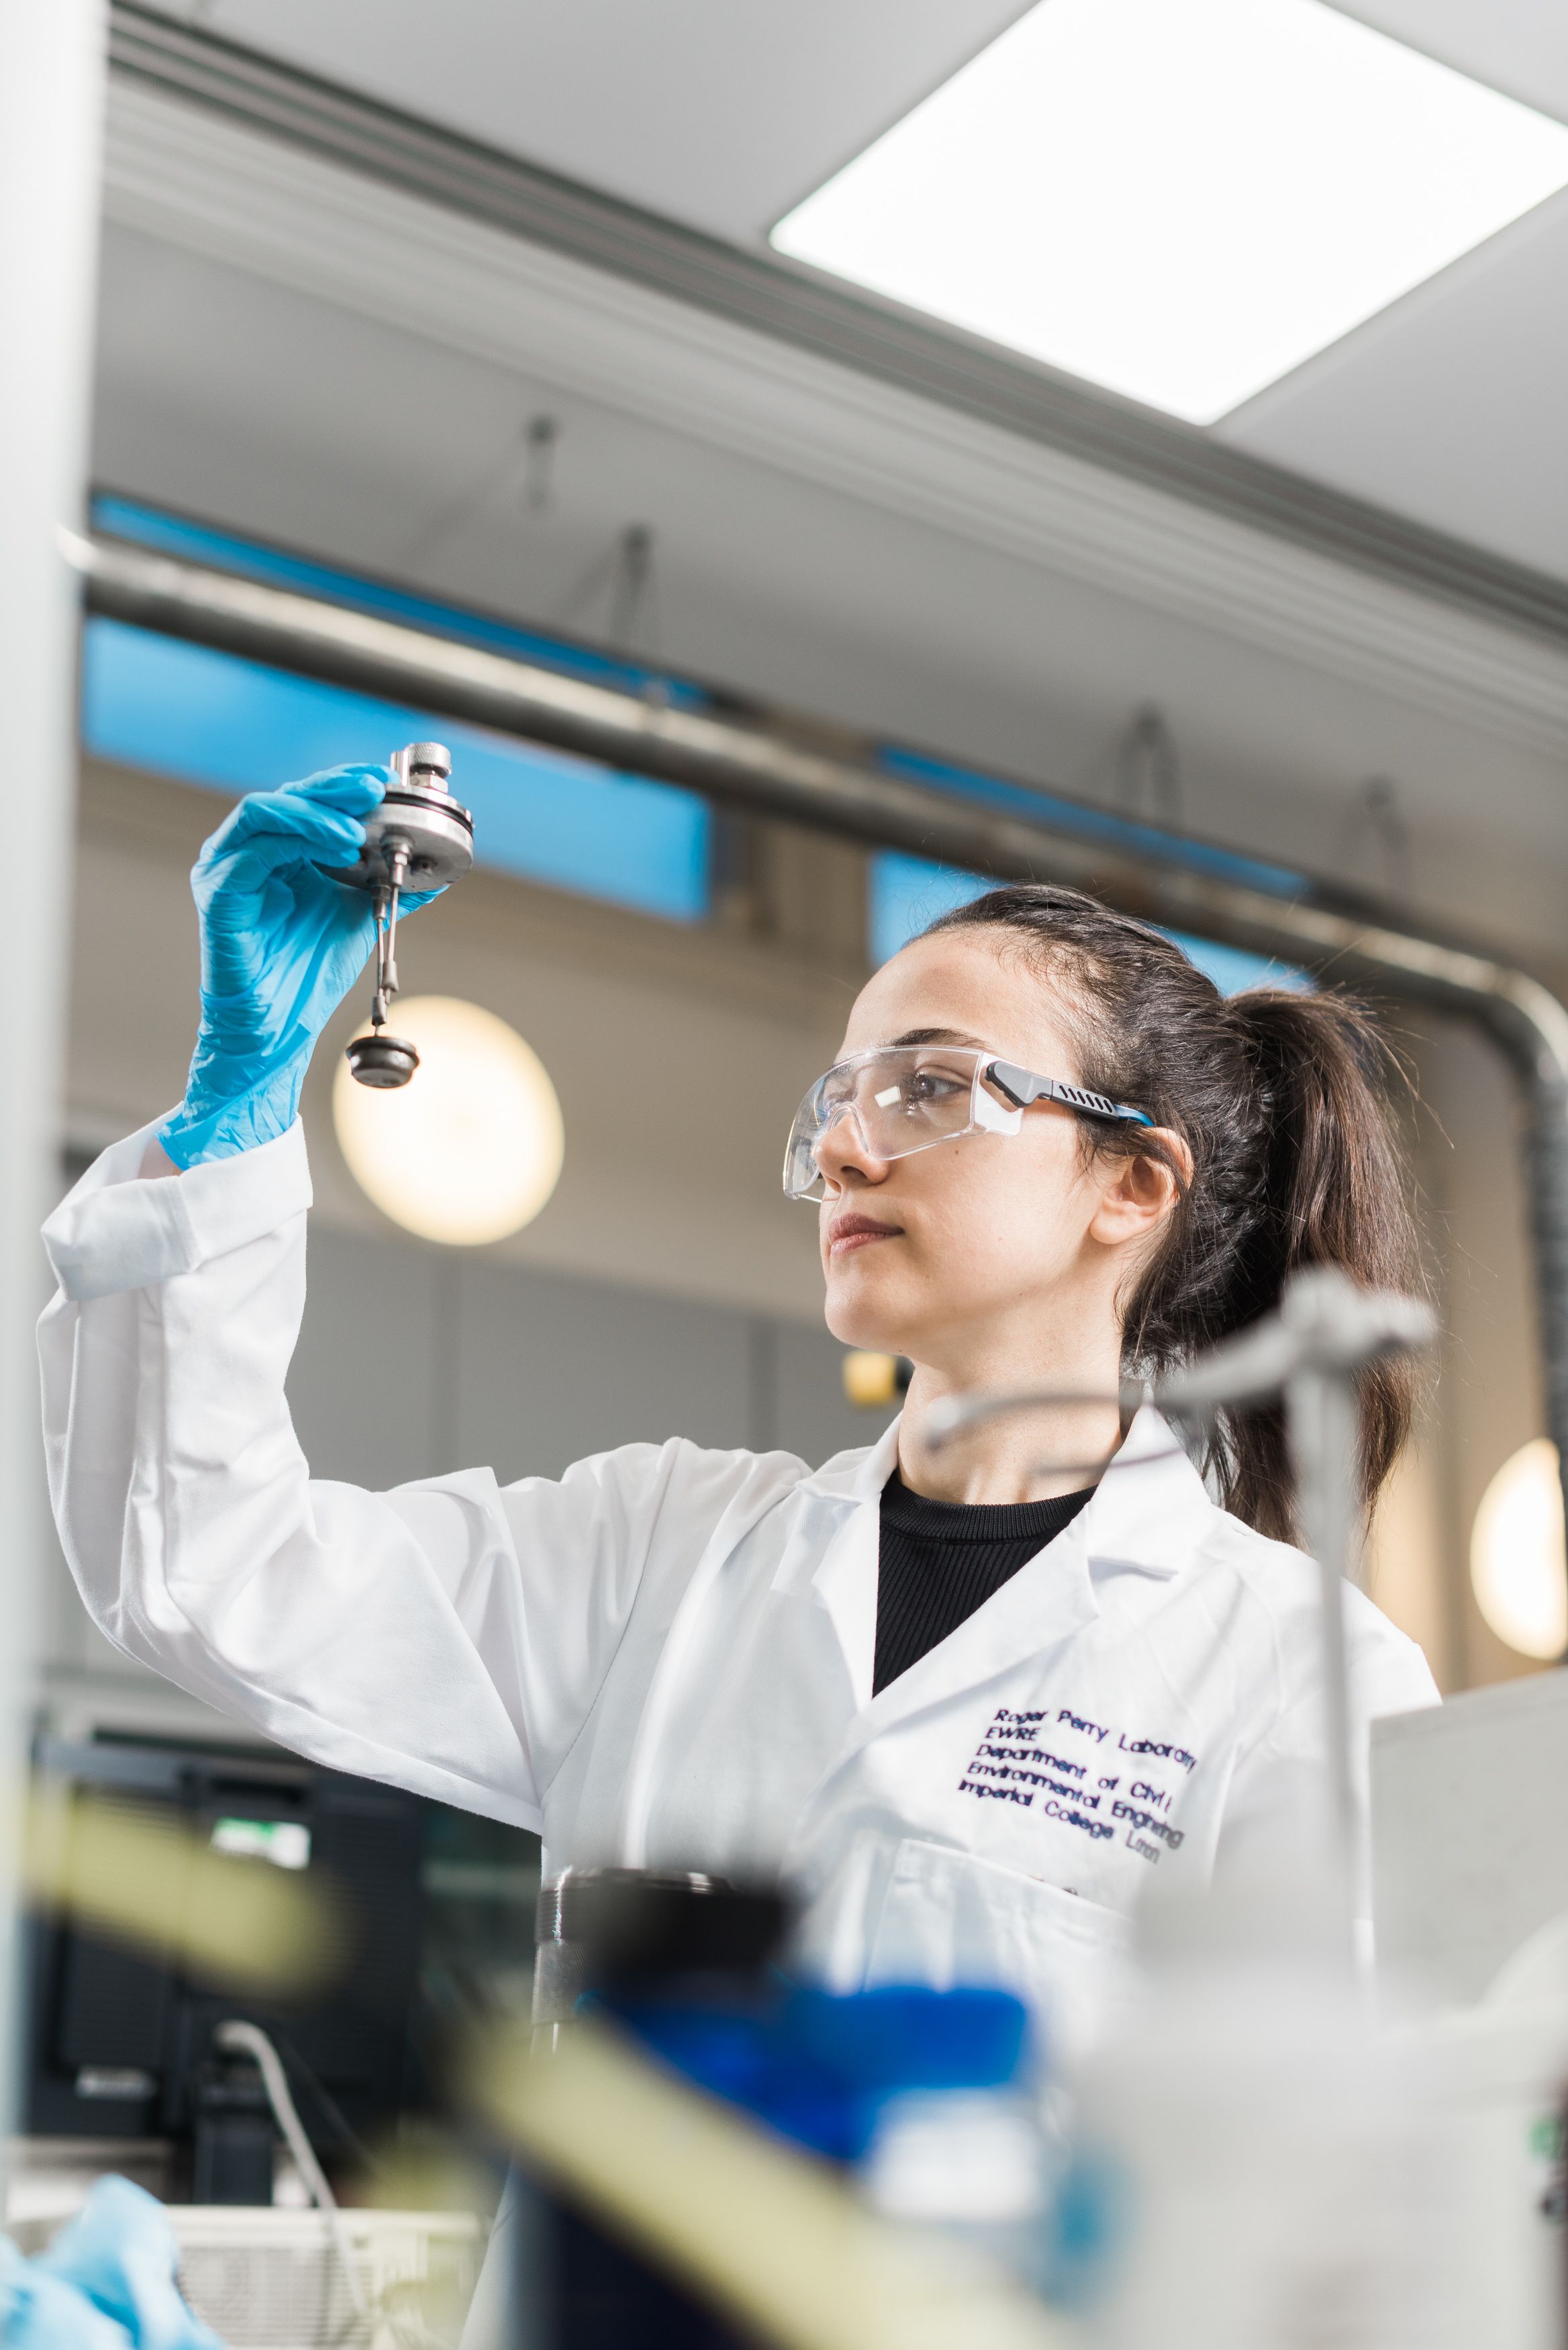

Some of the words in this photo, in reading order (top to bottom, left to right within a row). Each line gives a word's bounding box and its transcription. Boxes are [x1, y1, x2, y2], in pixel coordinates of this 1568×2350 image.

[985, 1727, 1042, 1742] EWRE
[1057, 1709, 1110, 1743] Perry
[976, 1744, 1087, 1781] Department
[967, 1761, 1101, 1809] Environmental
[958, 1779, 1034, 1807] Imperial
[1044, 1801, 1116, 1838] College
